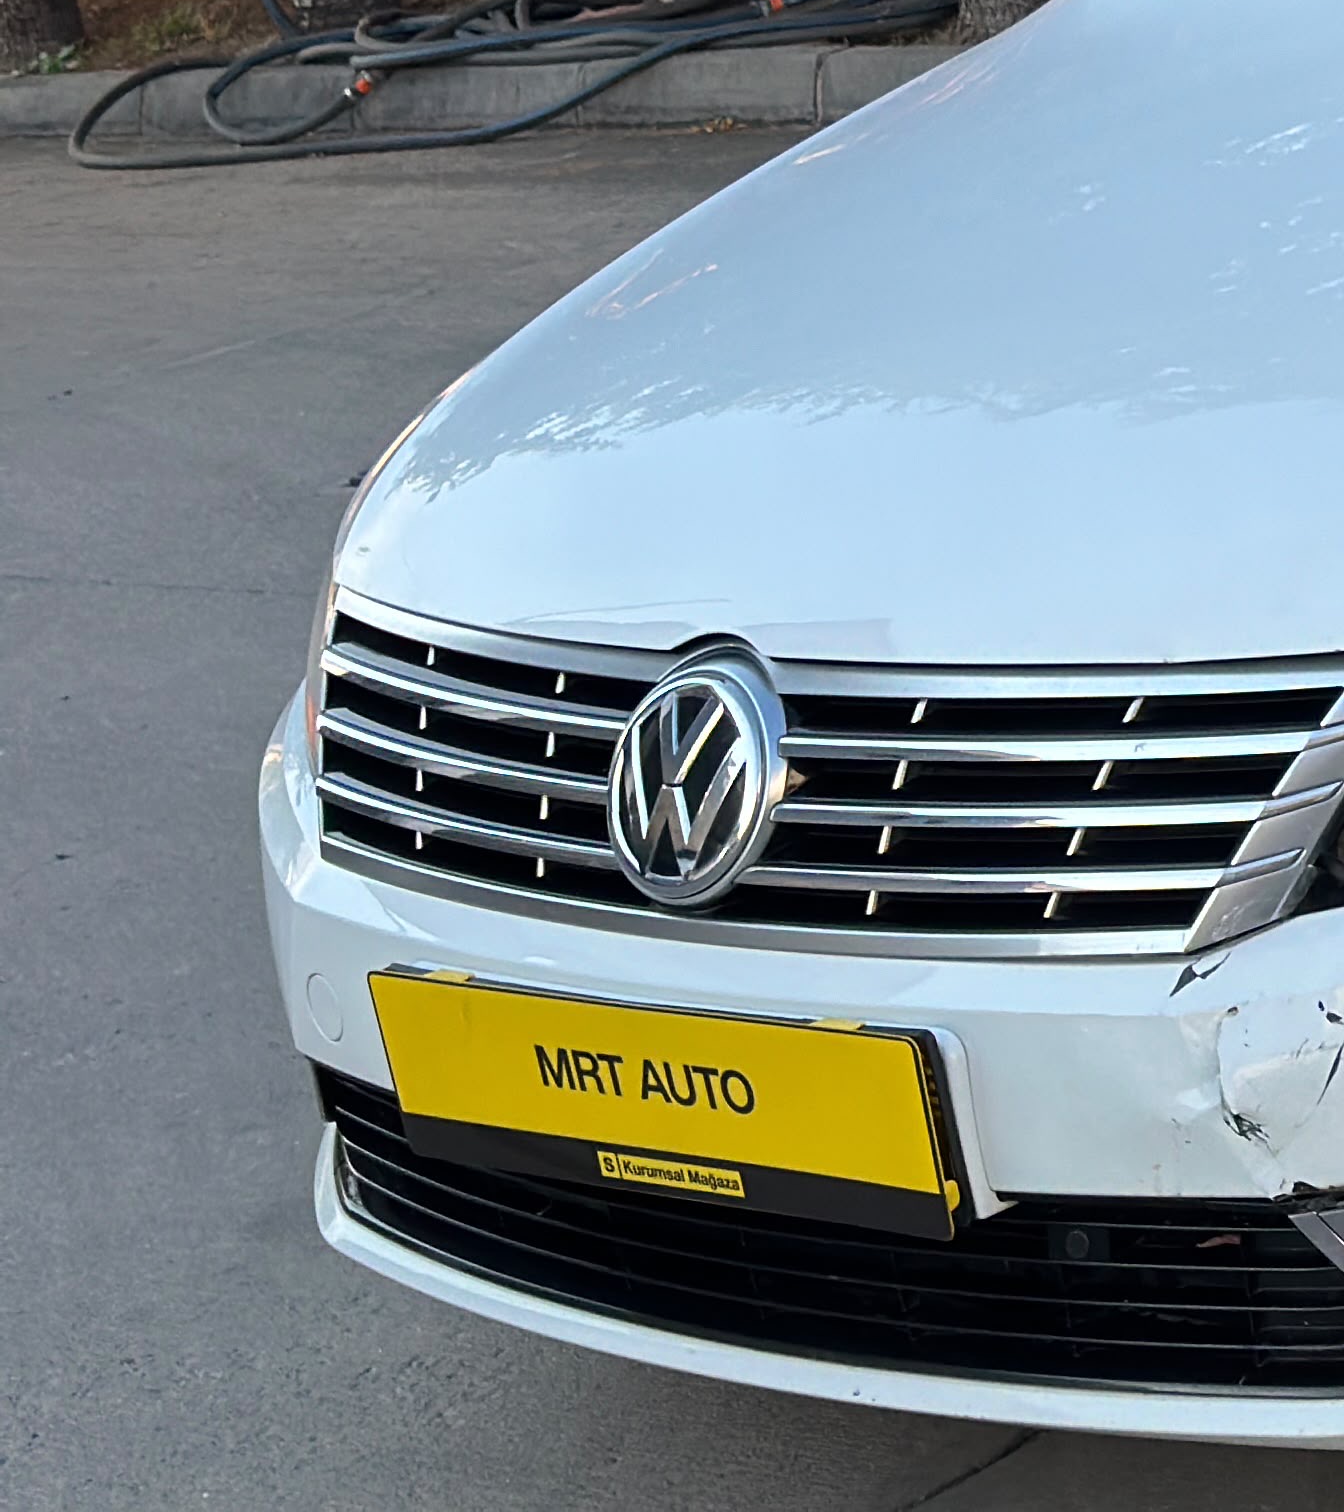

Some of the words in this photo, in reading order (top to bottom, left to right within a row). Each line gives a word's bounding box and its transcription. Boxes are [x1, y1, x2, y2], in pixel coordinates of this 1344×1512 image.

[612, 678, 764, 886] VW
[534, 1043, 624, 1097] MRT
[641, 1058, 755, 1115] AUTO
[603, 1157, 616, 1173] S
[622, 1159, 685, 1183] Kurumsal
[687, 1168, 741, 1191] Mağaza
